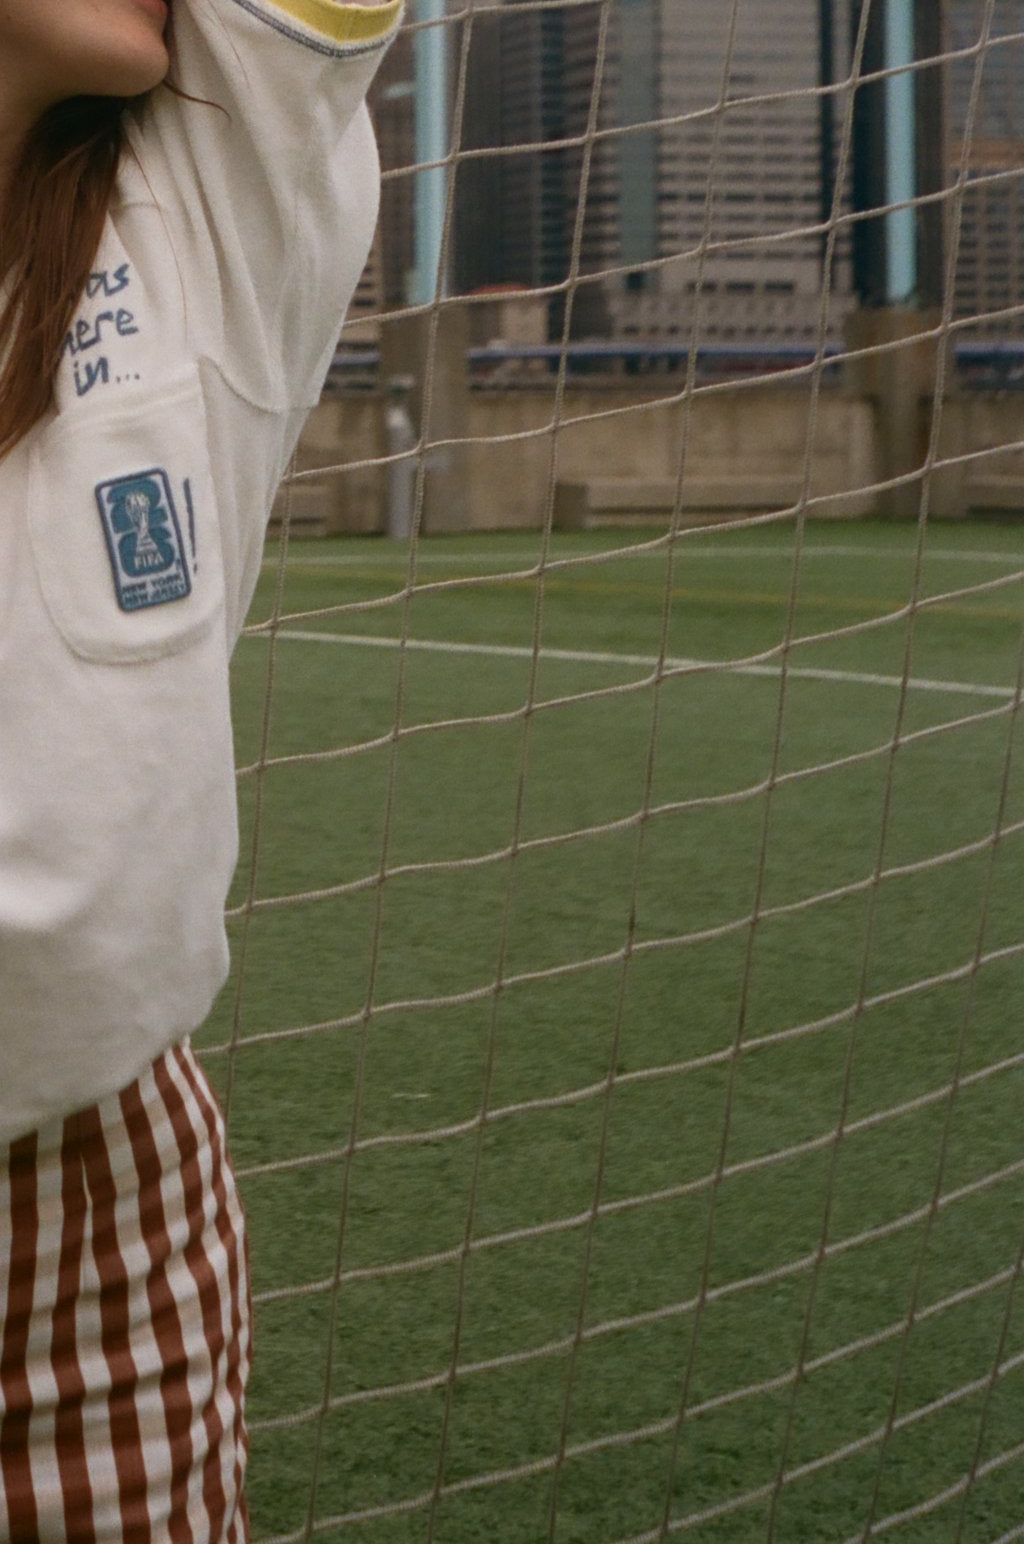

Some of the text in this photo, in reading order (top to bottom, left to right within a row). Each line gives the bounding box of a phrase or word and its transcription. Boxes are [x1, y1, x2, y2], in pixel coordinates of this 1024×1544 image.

[83, 263, 130, 299] as
[133, 553, 165, 570] FIFA
[122, 573, 183, 594] NEW YORK
